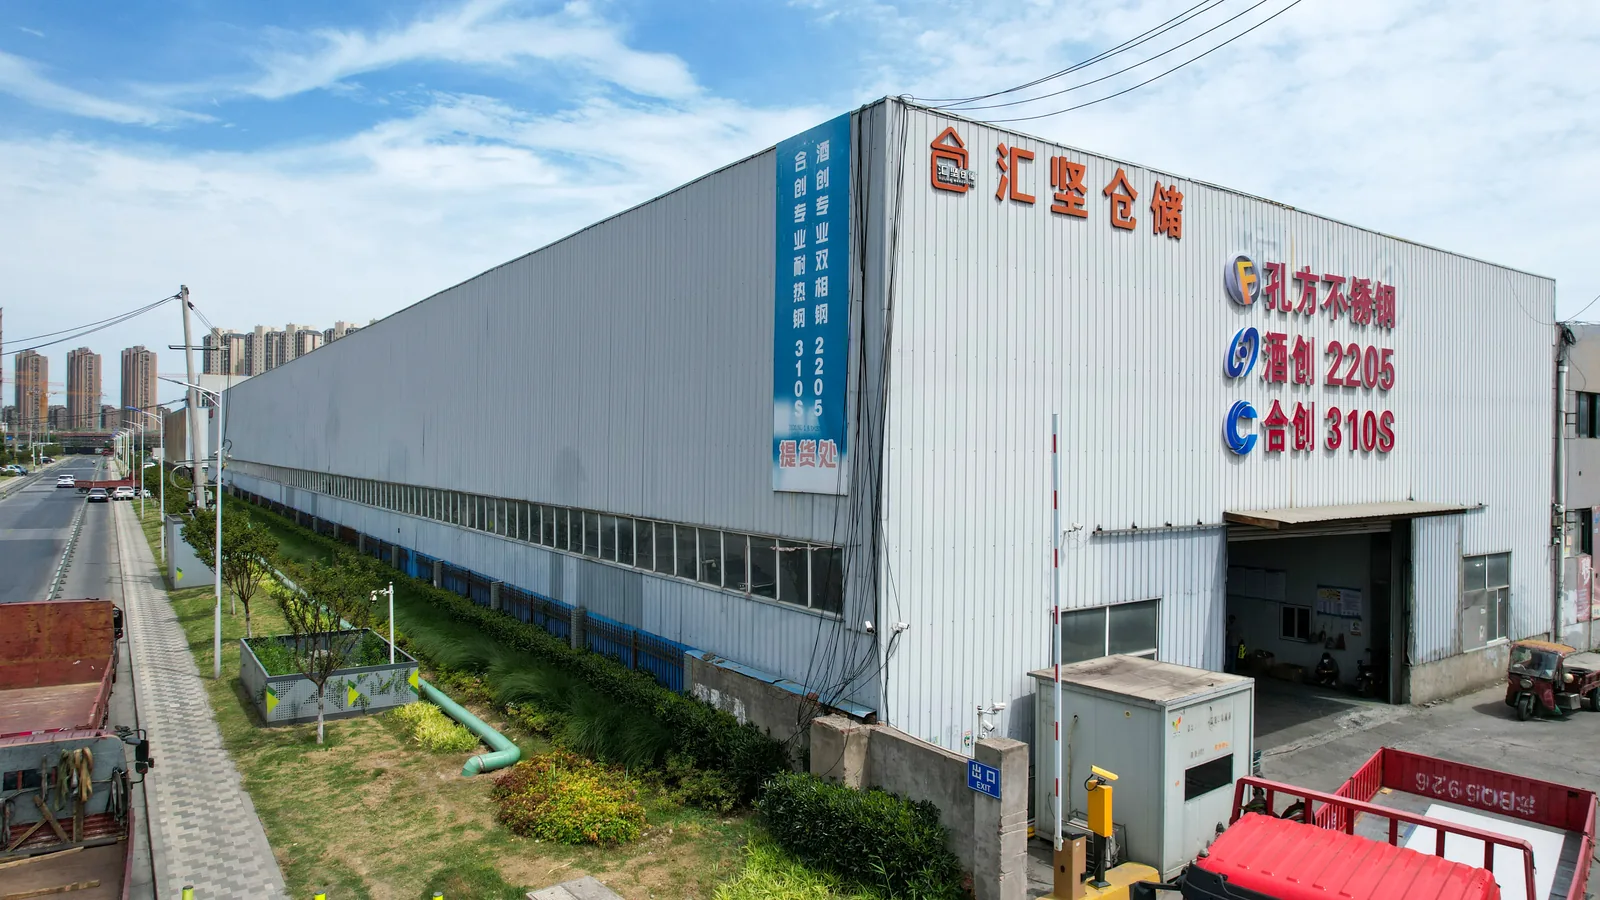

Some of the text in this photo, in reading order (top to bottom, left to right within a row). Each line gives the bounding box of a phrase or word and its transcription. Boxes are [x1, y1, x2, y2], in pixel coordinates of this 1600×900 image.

[995, 142, 1184, 240] 汇坚仓储
[793, 151, 807, 418] 合创专业耐热钢 310S
[814, 140, 829, 417] 酒创专业双相钢 2205
[1263, 261, 1396, 329] 孔方不锈钢
[1260, 331, 1396, 391] 酒创 2205
[779, 439, 838, 469] 提货处
[1261, 399, 1395, 453] 合创 310S
[972, 764, 995, 784] 出口
[976, 781, 991, 792] EXIT
